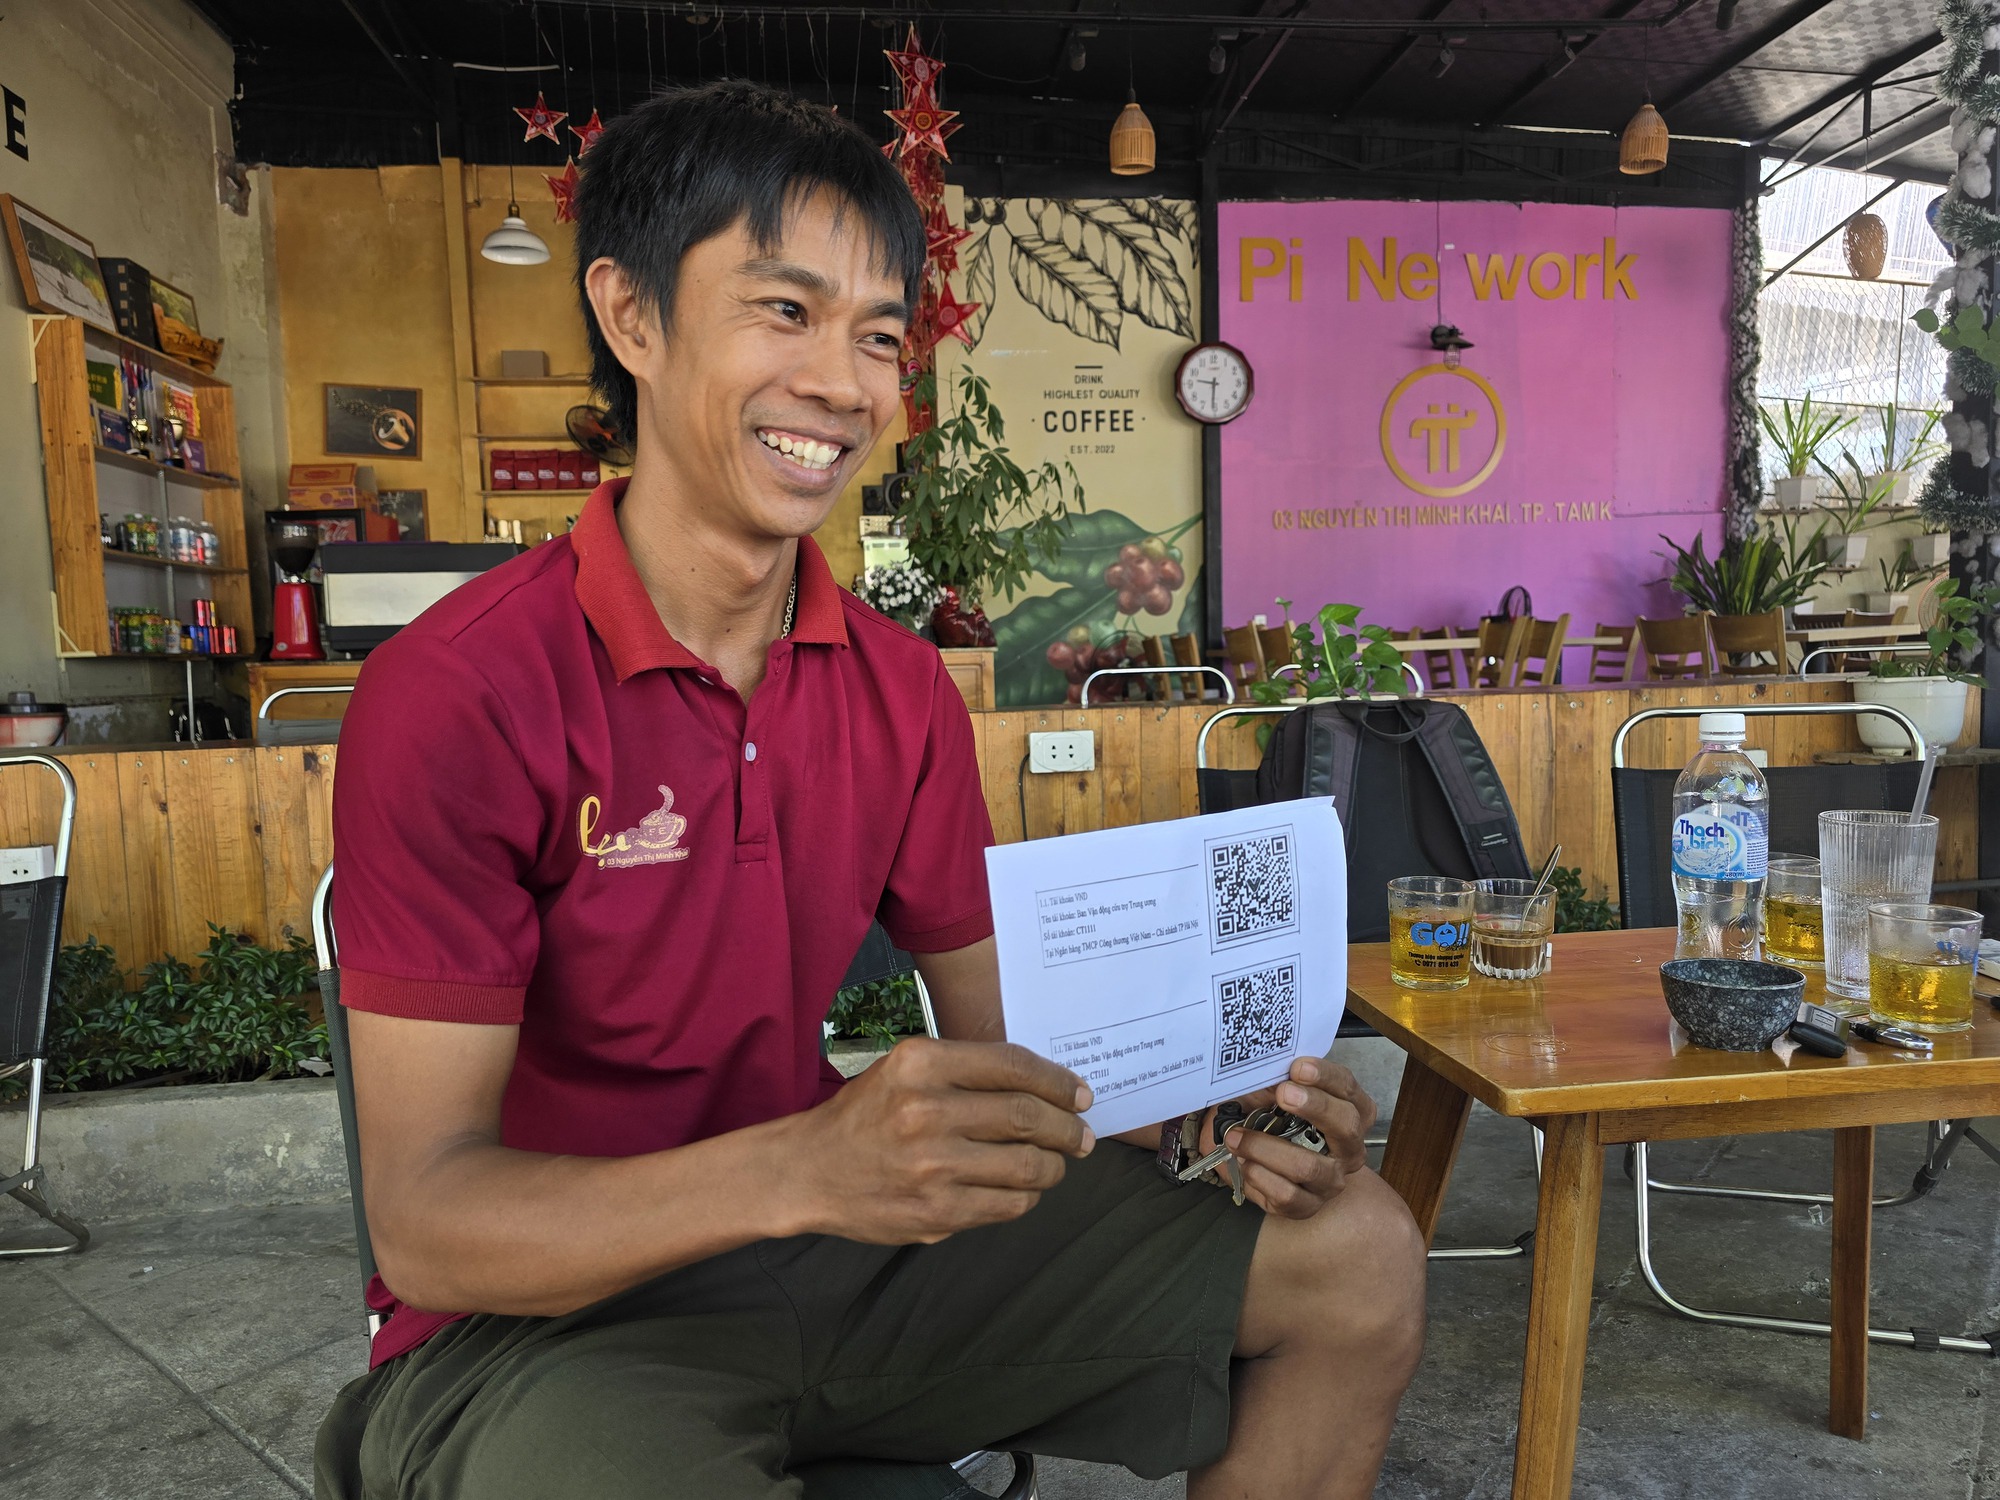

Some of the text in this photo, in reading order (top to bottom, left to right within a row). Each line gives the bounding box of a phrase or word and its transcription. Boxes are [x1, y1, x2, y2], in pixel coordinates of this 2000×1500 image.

[1239, 237, 1302, 302] Pi
[1074, 375, 1104, 384] DRINK
[1043, 389, 1140, 399] HIGHLEST QUALITY
[1044, 410, 1134, 433] COFFEE
[1095, 445, 1115, 454] 2022
[1272, 509, 1293, 530] 03
[656, 851, 674, 860] Minh
[1129, 900, 1143, 909] Trung
[1076, 924, 1096, 935] CT1111
[1082, 940, 1098, 951] TMCP
[1140, 931, 1151, 940] Nam
[1090, 1068, 1109, 1080] CT1111
